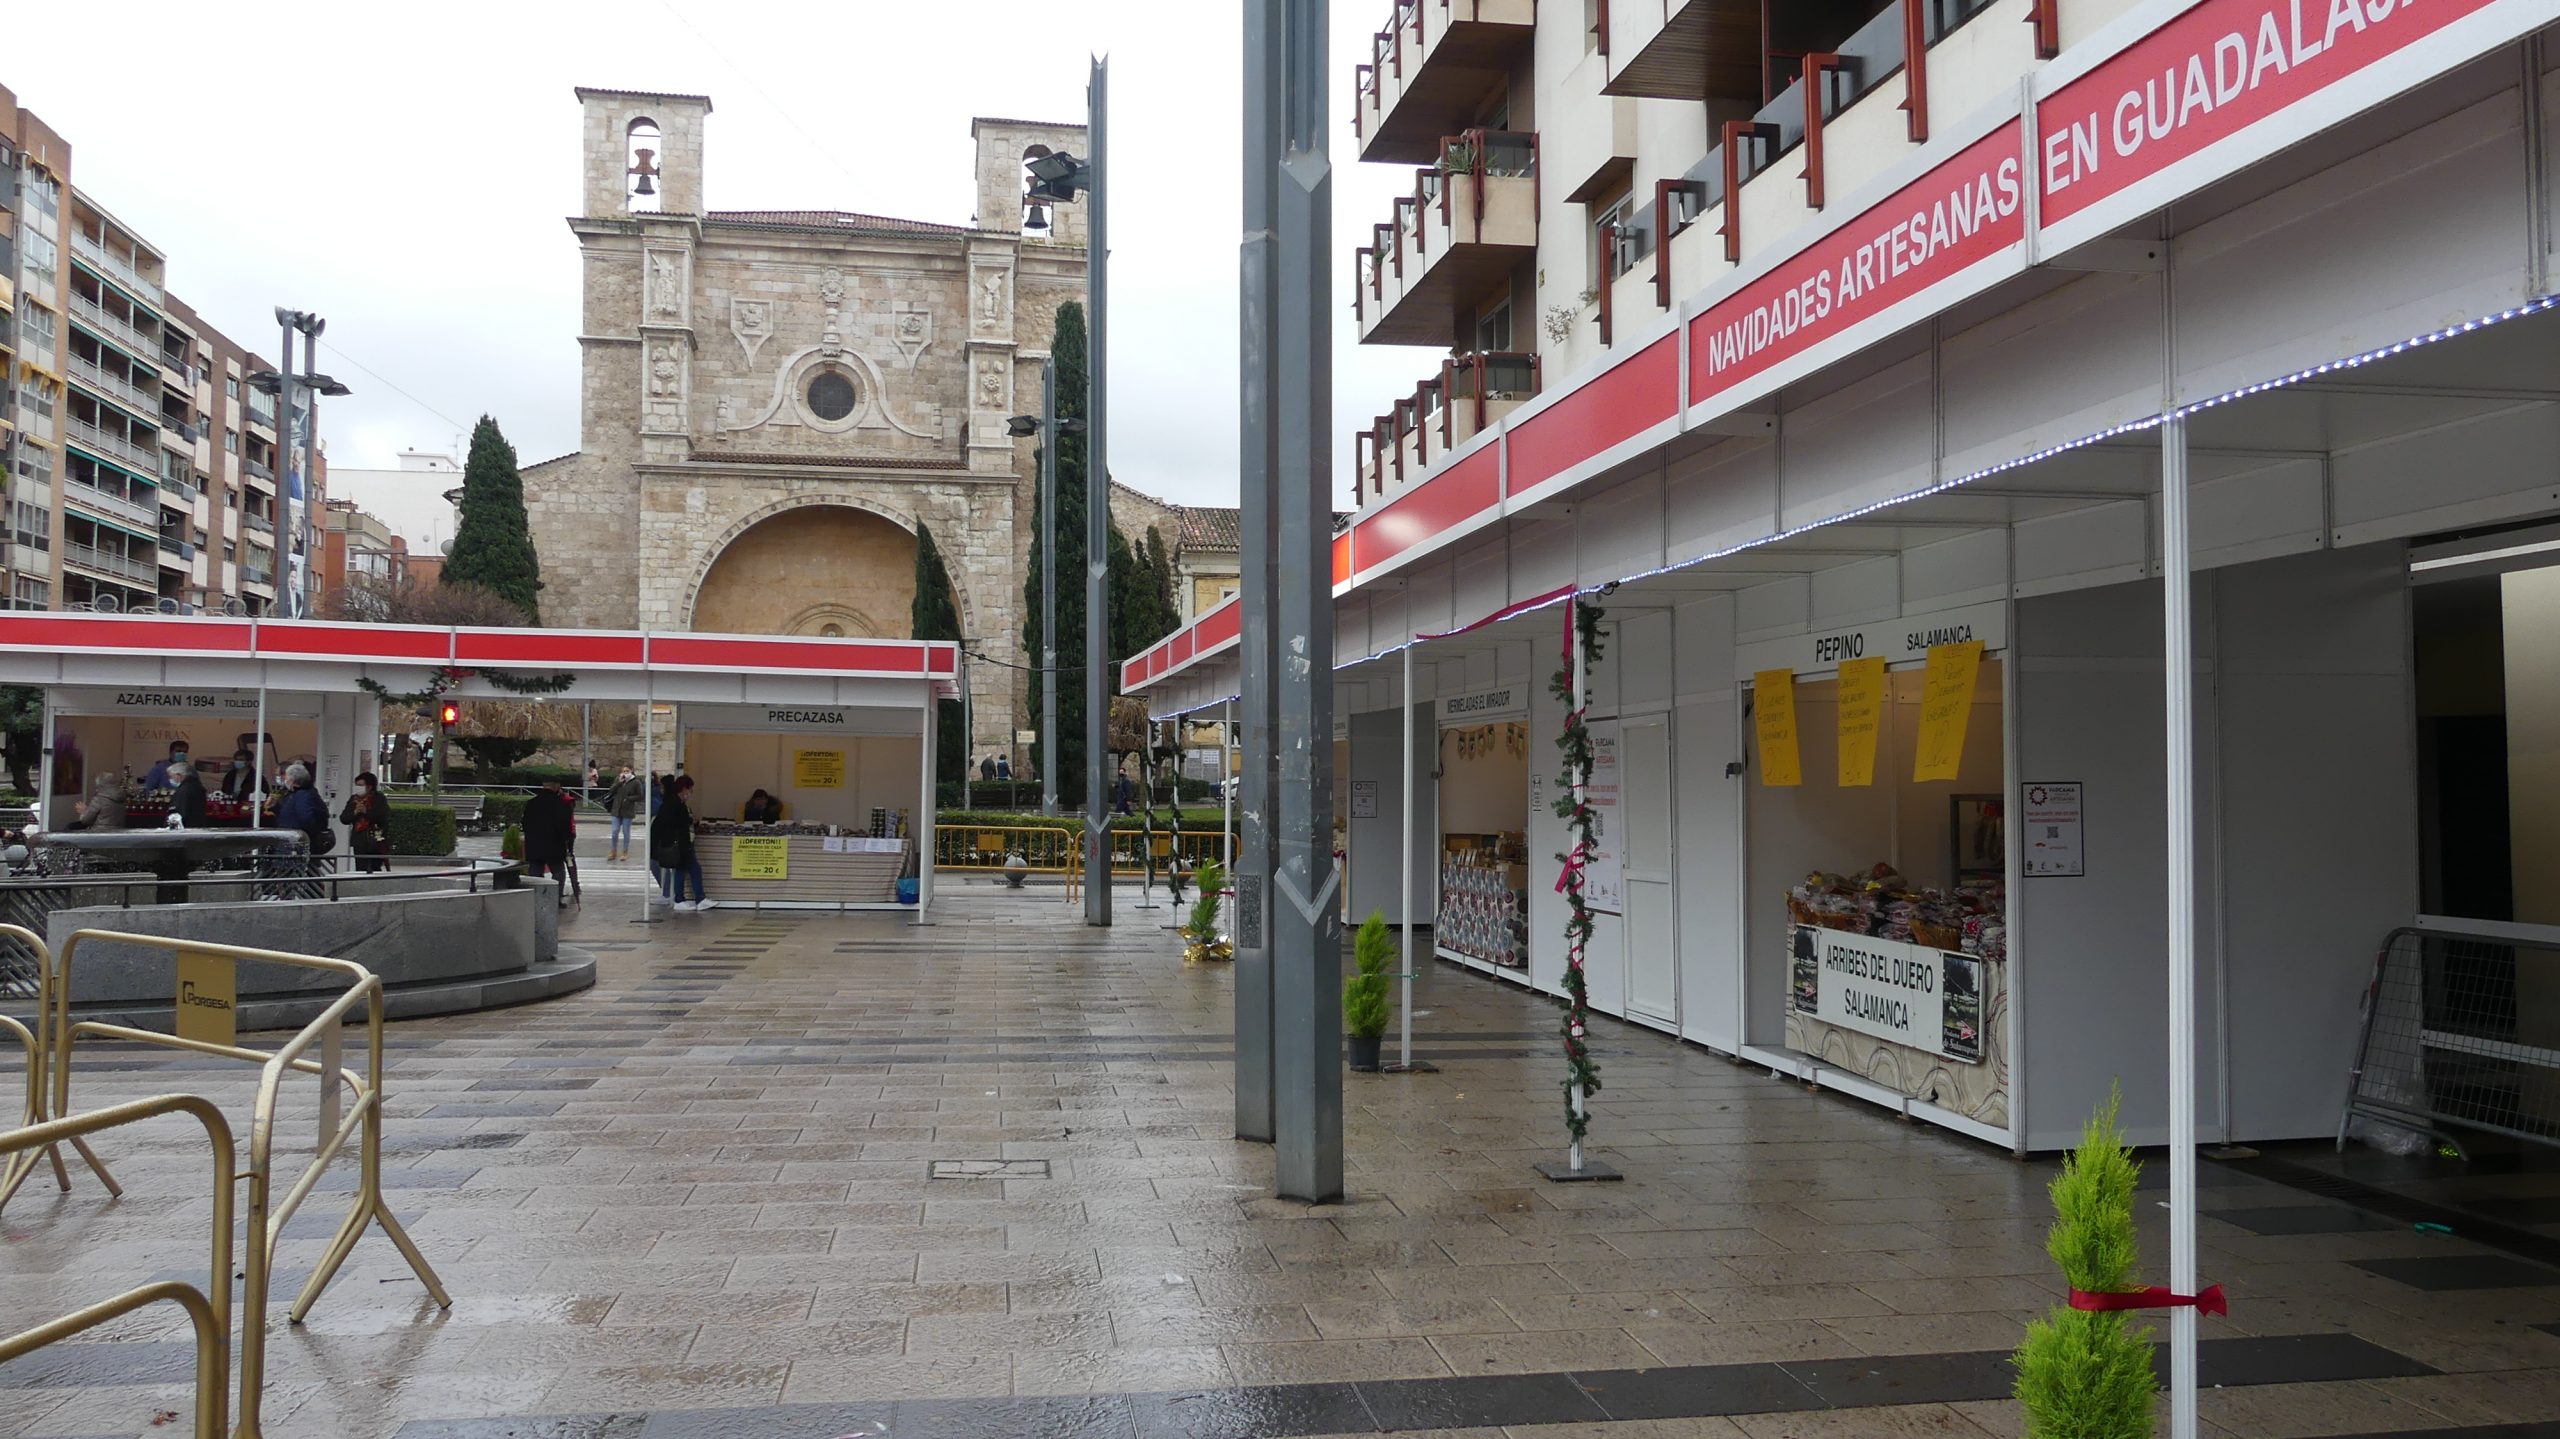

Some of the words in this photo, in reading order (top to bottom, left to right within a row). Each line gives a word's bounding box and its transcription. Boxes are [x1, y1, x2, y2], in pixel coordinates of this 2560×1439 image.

[1709, 269, 1832, 377] NAVIDADES
[1837, 157, 2019, 309] ARTESANAS
[2045, 111, 2099, 196] EN
[2112, 0, 2413, 157] GUADALA
[1815, 633, 1864, 663] PEPINO
[1906, 625, 1973, 651] SALAMANCA
[116, 693, 182, 707] AZAFRAN
[186, 695, 216, 707] 1994
[224, 699, 260, 708] TOLEDO
[768, 710, 844, 724] PRECAZASA
[1447, 696, 1478, 713] MERMELADAS
[1480, 694, 1486, 710] EL
[1487, 690, 1510, 708] MIRADOR
[1826, 944, 1867, 978] ARRIBES
[1870, 953, 1890, 984] DEL
[1893, 958, 1934, 994] DUERO
[1845, 988, 1909, 1031] SALAMANCA
